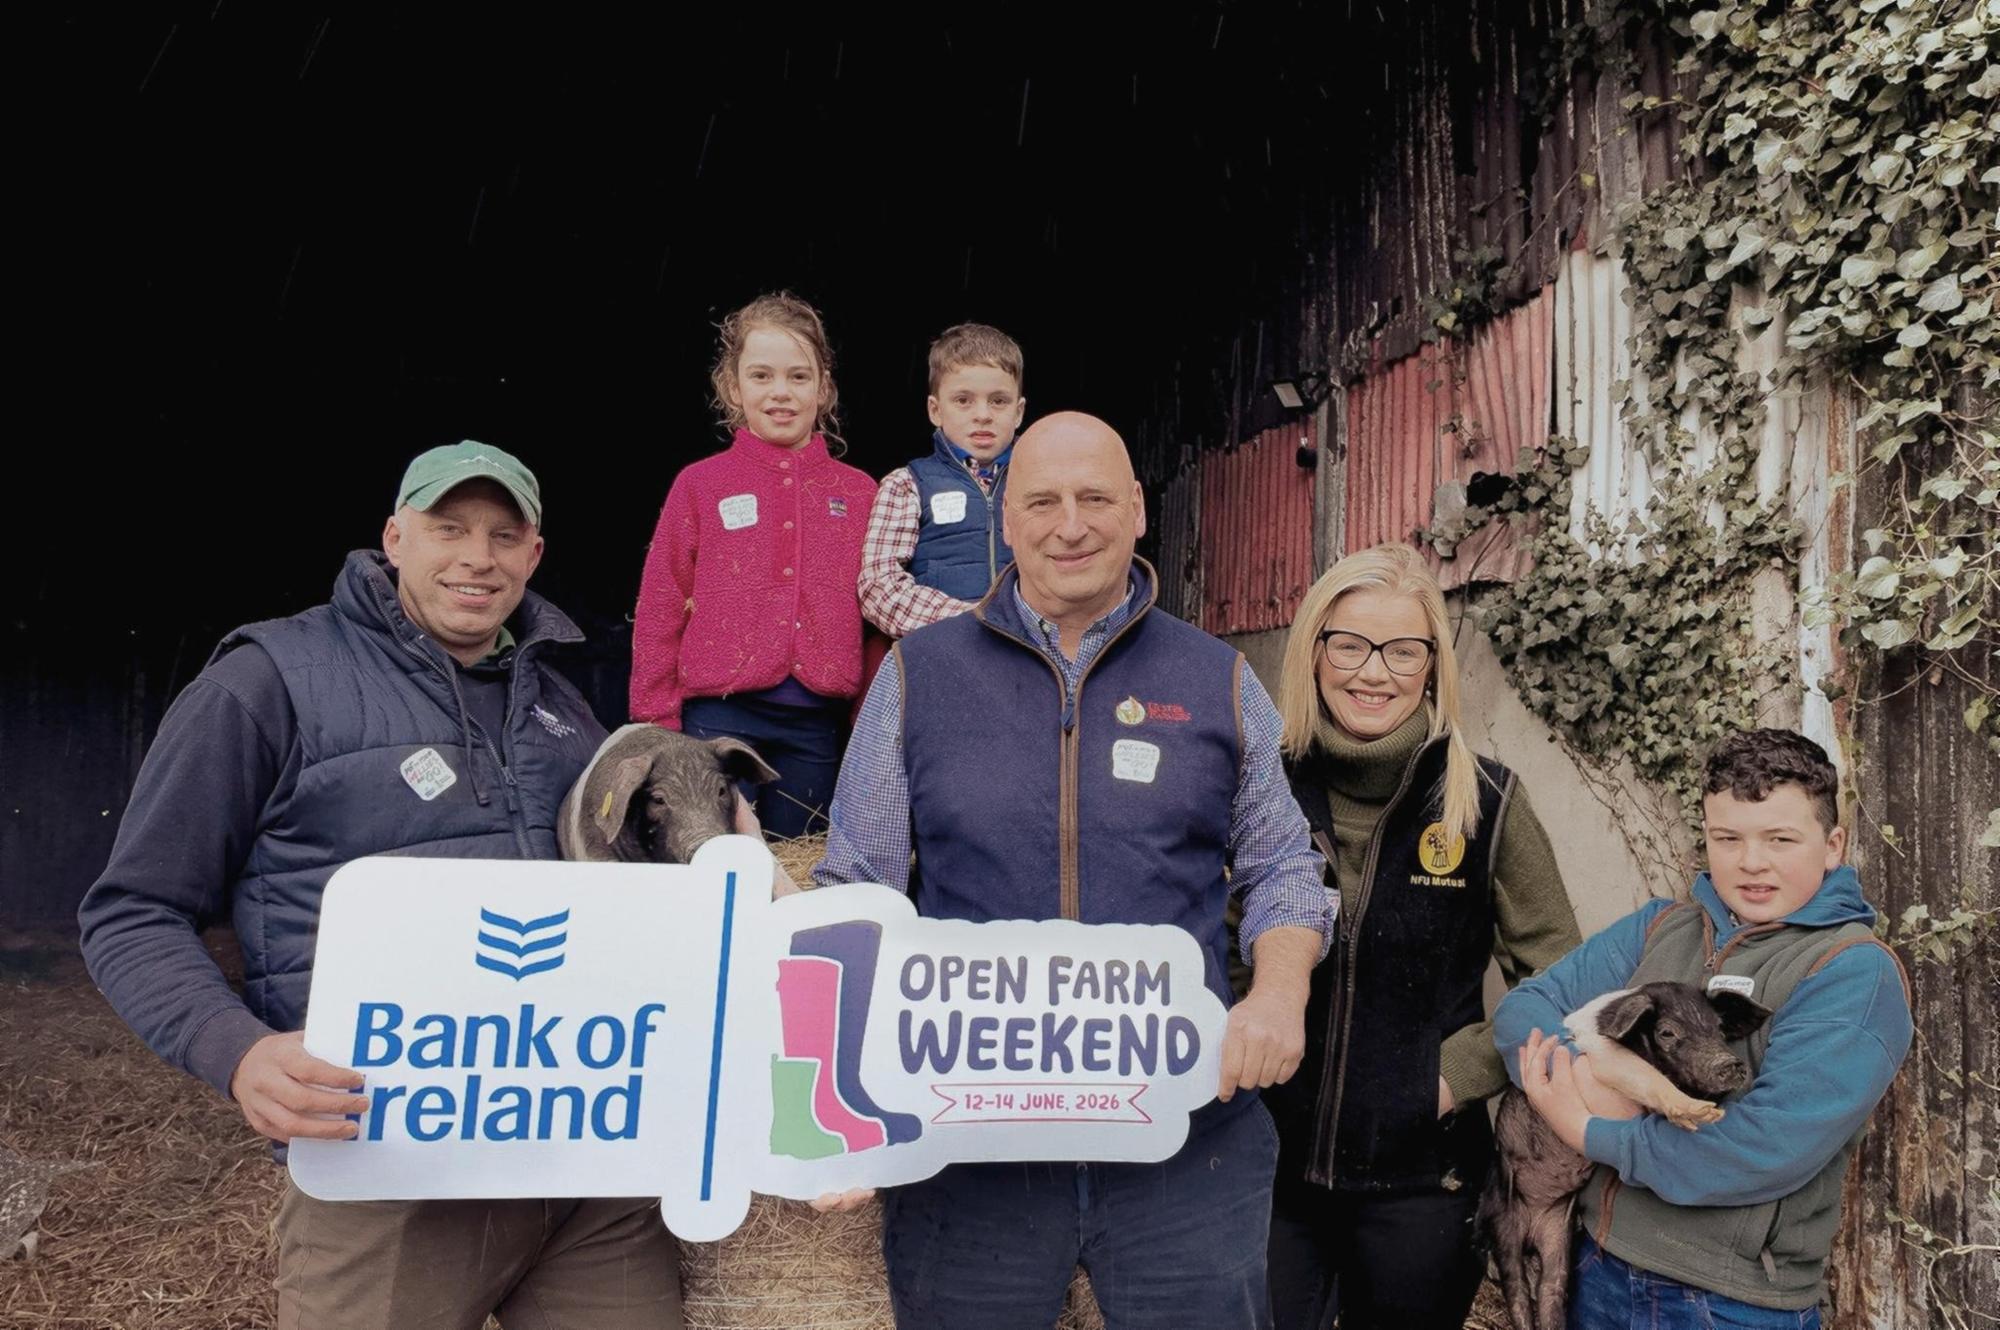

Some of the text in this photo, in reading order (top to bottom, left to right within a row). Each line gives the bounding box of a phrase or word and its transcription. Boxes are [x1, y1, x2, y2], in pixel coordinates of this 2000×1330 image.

[1410, 874, 1466, 888] NFU Mutual
[899, 953, 1171, 1007] OPEN FARM
[351, 1002, 666, 1069] Bank of
[899, 1009, 1202, 1077] WEEKEND
[1020, 1093, 1070, 1112] JUNE,
[1075, 1093, 1120, 1111] 2026
